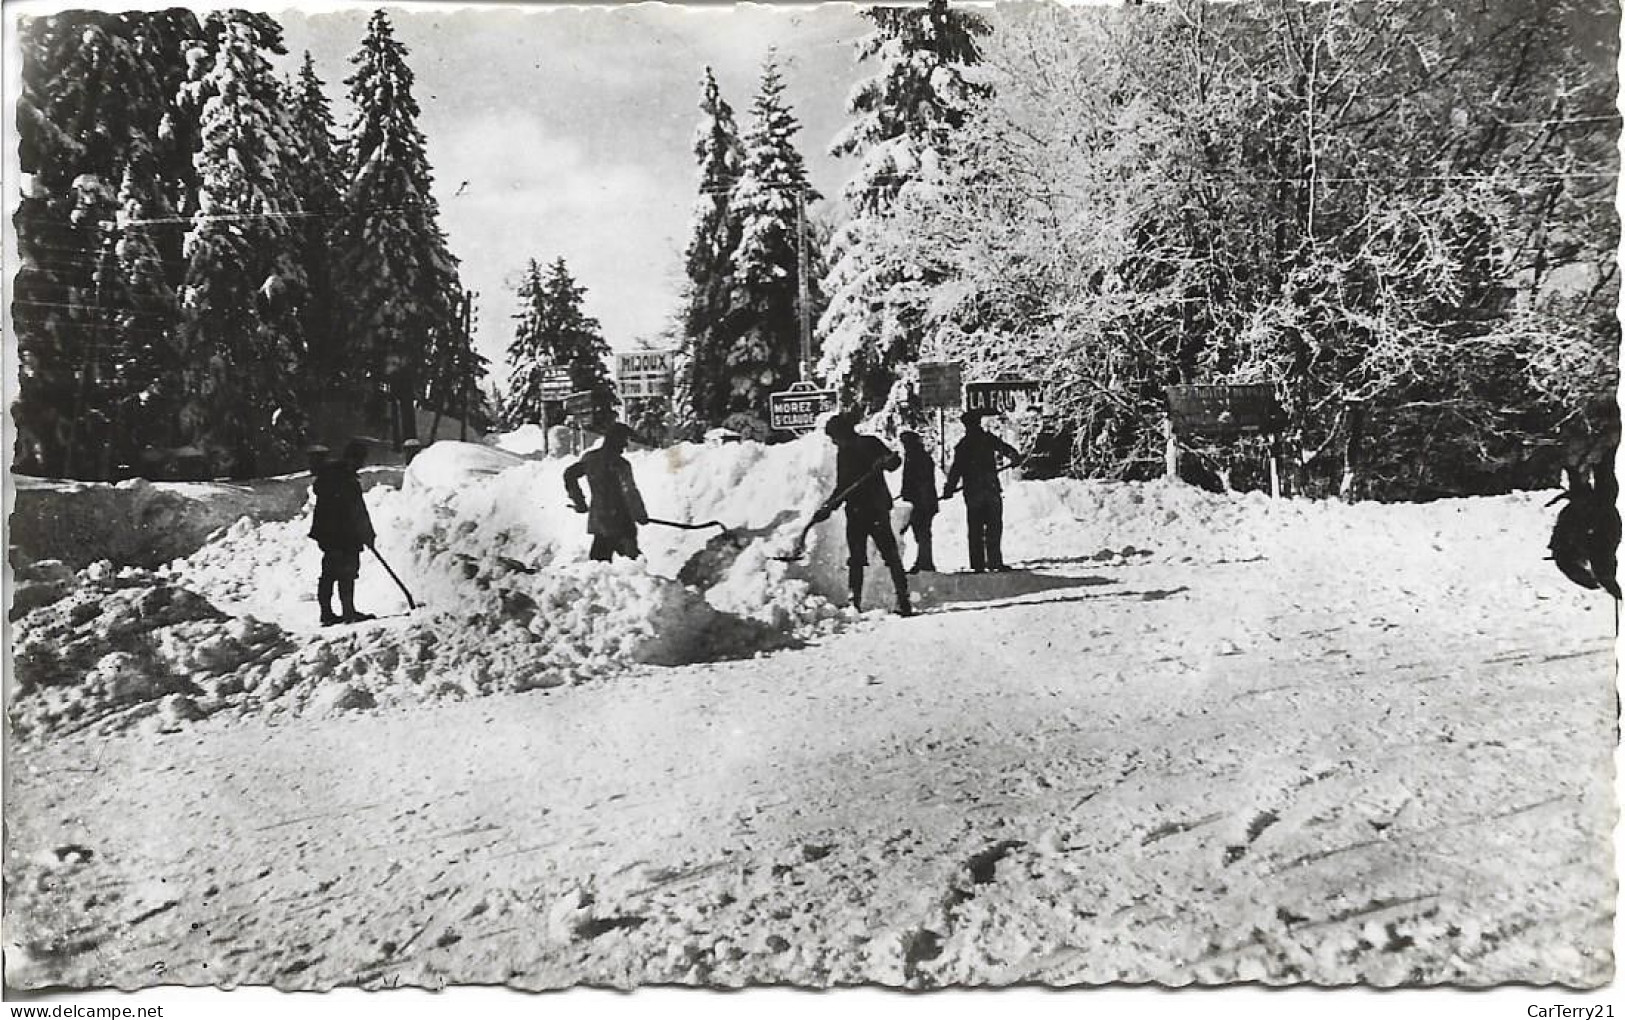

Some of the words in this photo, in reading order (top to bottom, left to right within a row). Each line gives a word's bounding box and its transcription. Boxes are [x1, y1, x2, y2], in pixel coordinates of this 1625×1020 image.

[622, 355, 668, 371] MIJOUX
[774, 401, 811, 413] MOREZ
[969, 391, 985, 409] LA
